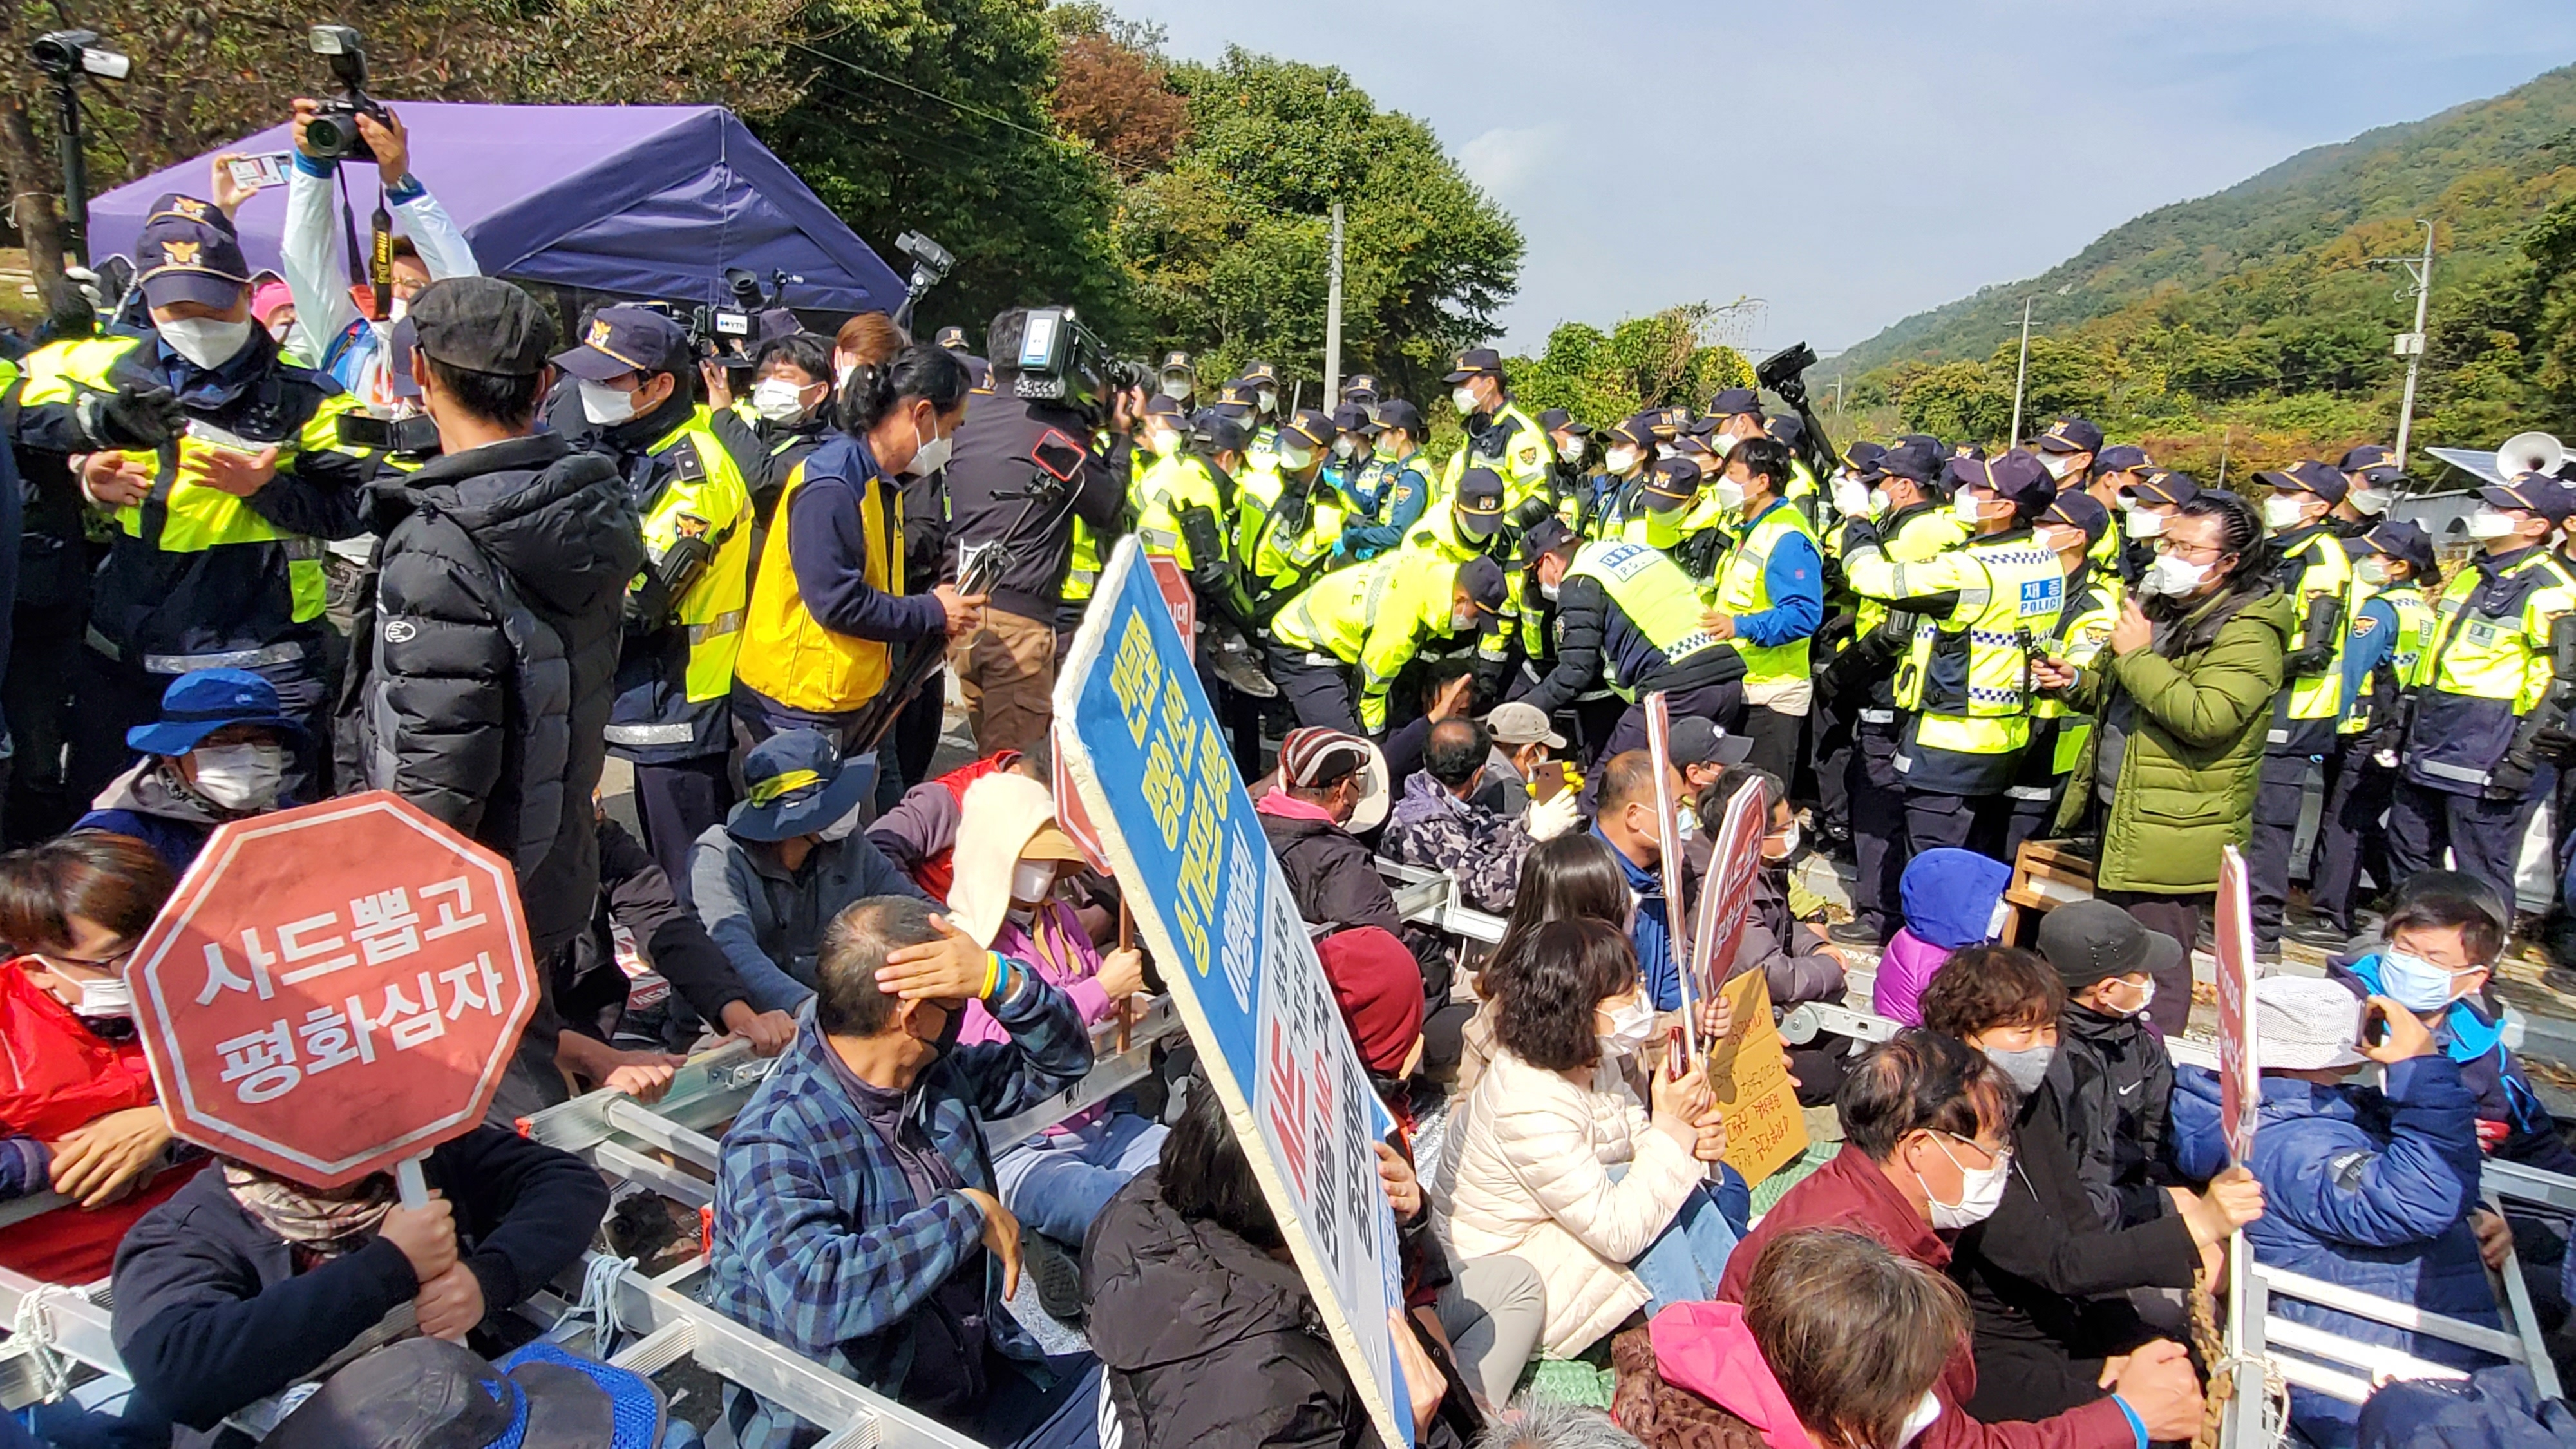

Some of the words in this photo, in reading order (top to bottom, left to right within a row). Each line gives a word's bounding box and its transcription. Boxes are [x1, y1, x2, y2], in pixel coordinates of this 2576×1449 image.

[375, 230, 388, 263] Nikon
[1110, 607, 1161, 748] 판문점
[1141, 726, 1184, 851] 평양
[1164, 670, 1197, 775] 선언
[1175, 780, 1222, 978] 싱가포르
[1199, 719, 1230, 819] 성명
[1220, 819, 1257, 1014] 이행하라!
[194, 875, 488, 1006] 사드뽑고
[215, 952, 505, 1104] 평화심자
[1314, 982, 1332, 1060] 구축
[1314, 1050, 1332, 1135] MD
[1269, 1016, 1306, 1202] 사드
[1341, 1032, 1372, 1259] 중단하라!
[1314, 1113, 1338, 1274] 한미일
